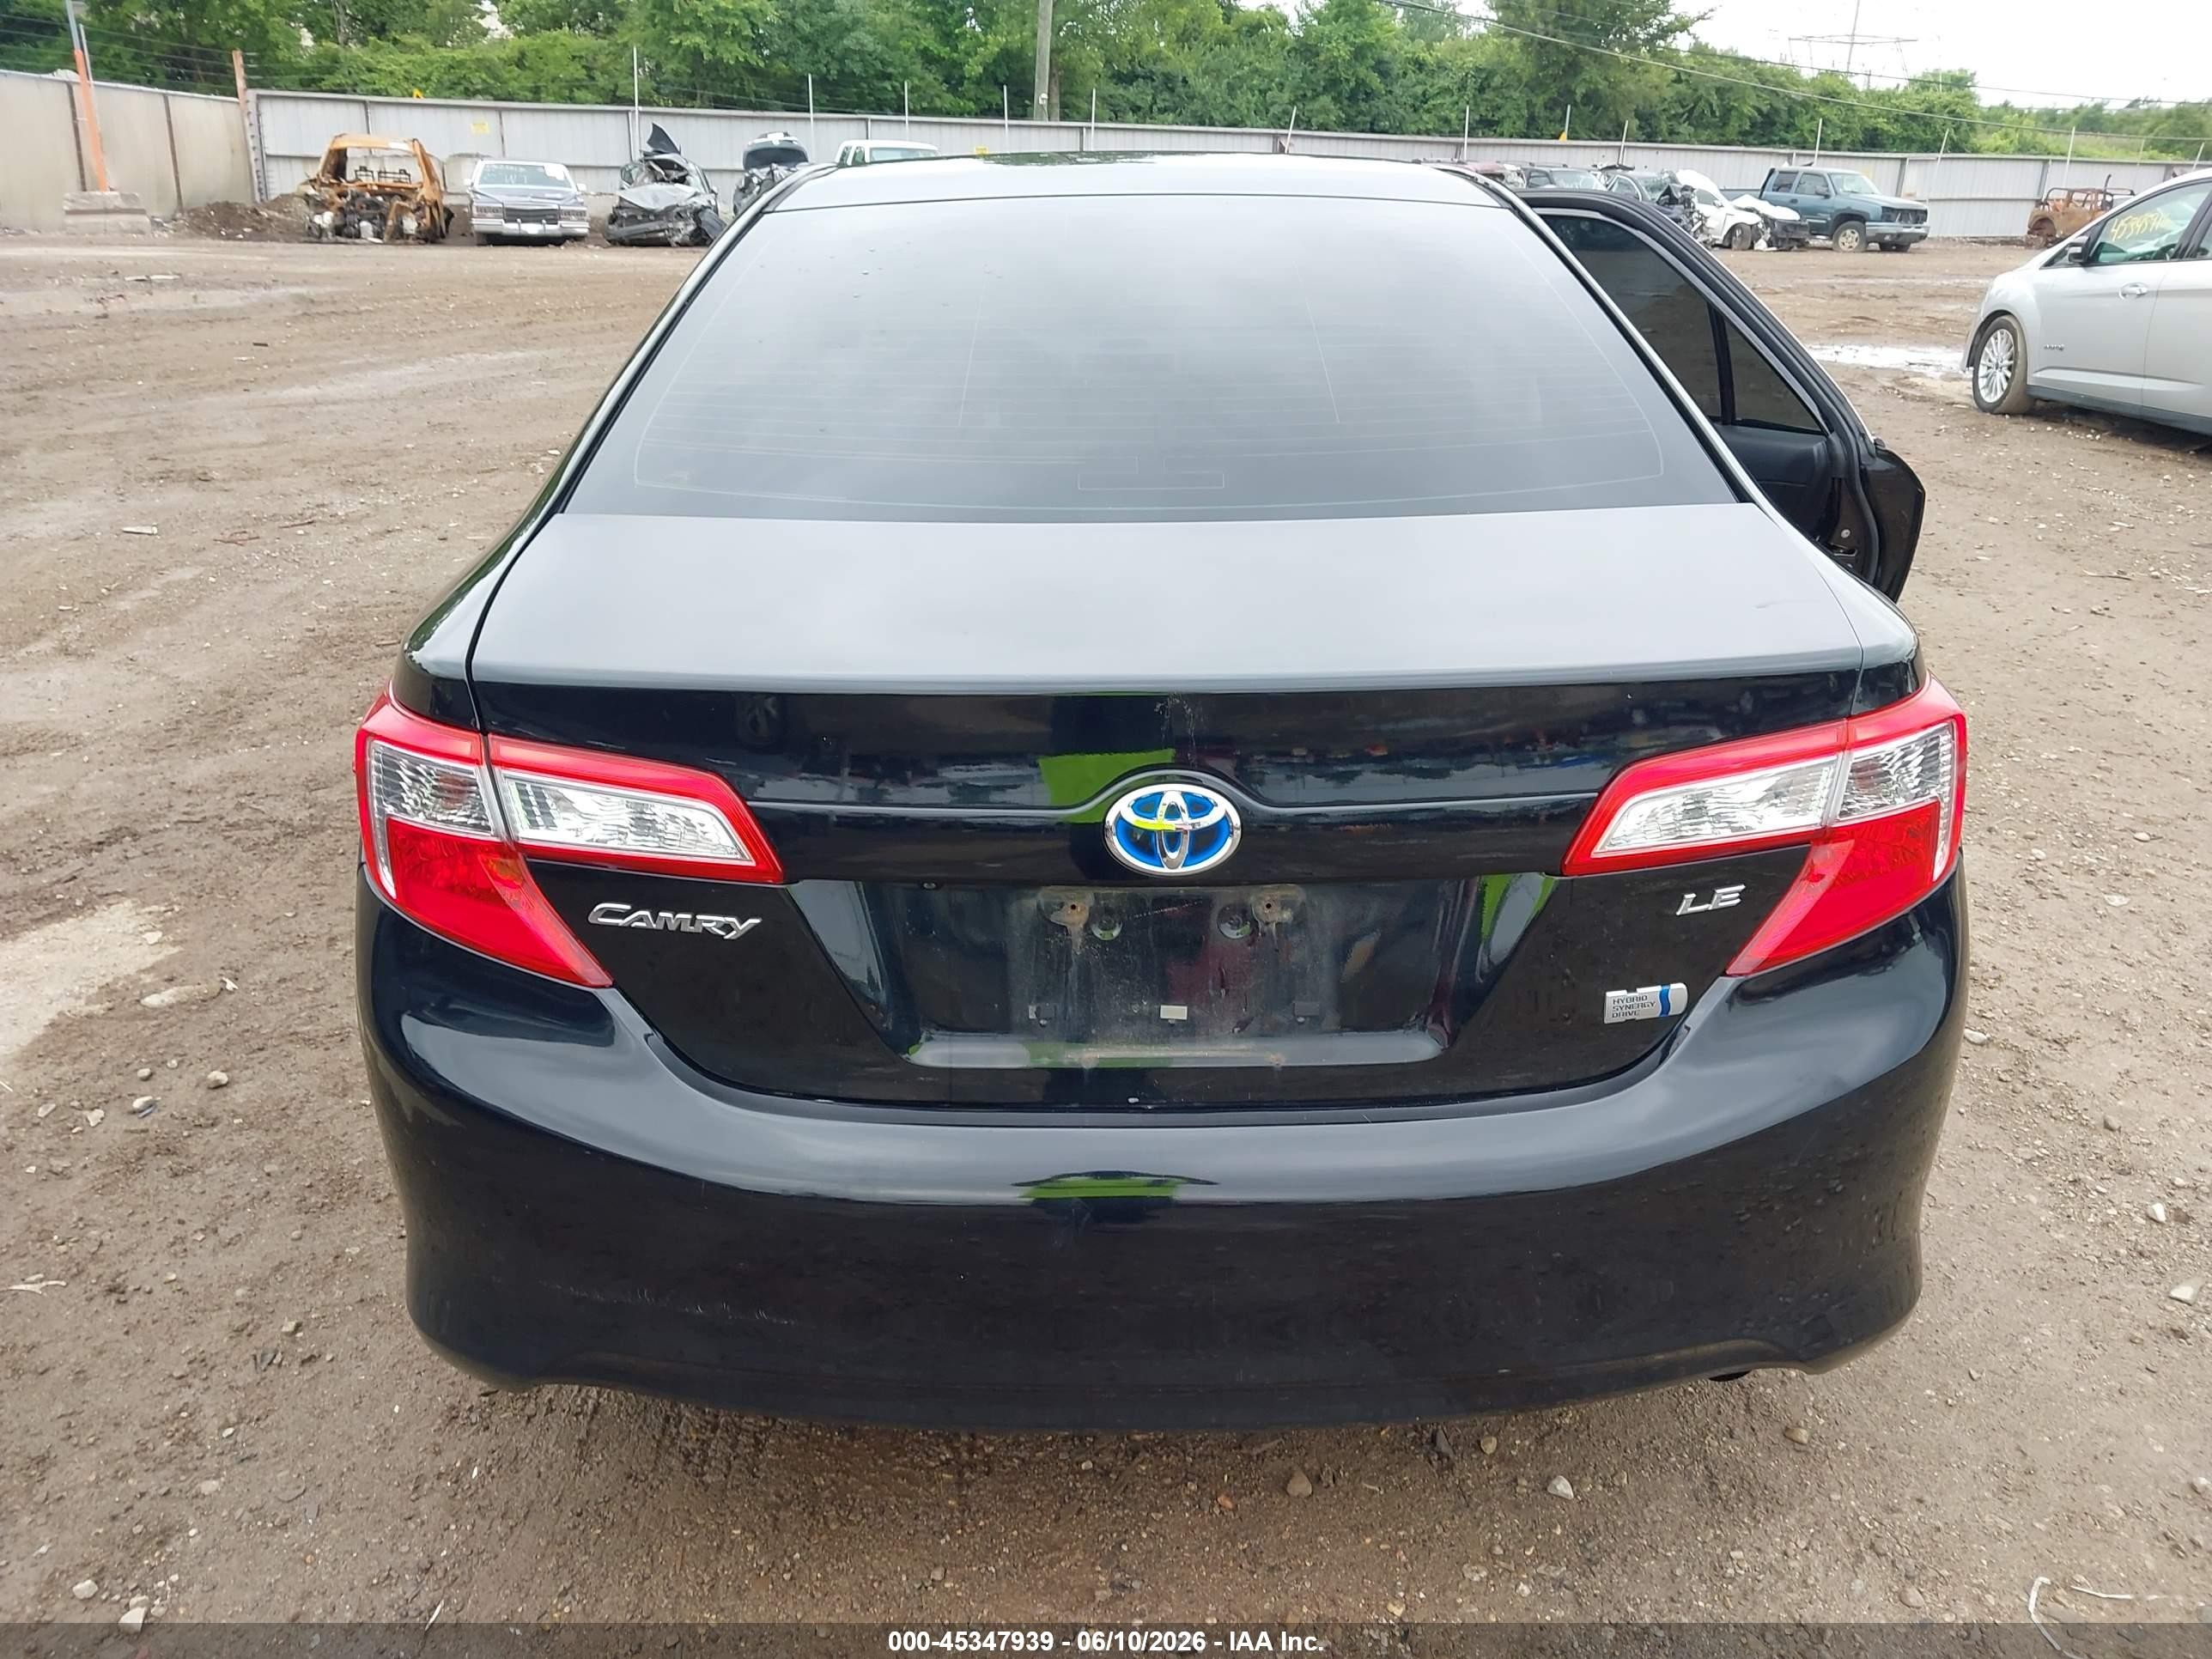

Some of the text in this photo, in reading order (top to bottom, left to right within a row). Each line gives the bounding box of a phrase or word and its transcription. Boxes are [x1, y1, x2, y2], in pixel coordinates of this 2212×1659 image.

[1676, 884, 1746, 916] LE
[587, 902, 762, 939] CAMRY
[1613, 995, 1648, 1005] HYBRID
[1613, 1001, 1656, 1011] SYNERGY
[1612, 1010, 1640, 1018] DRIVE
